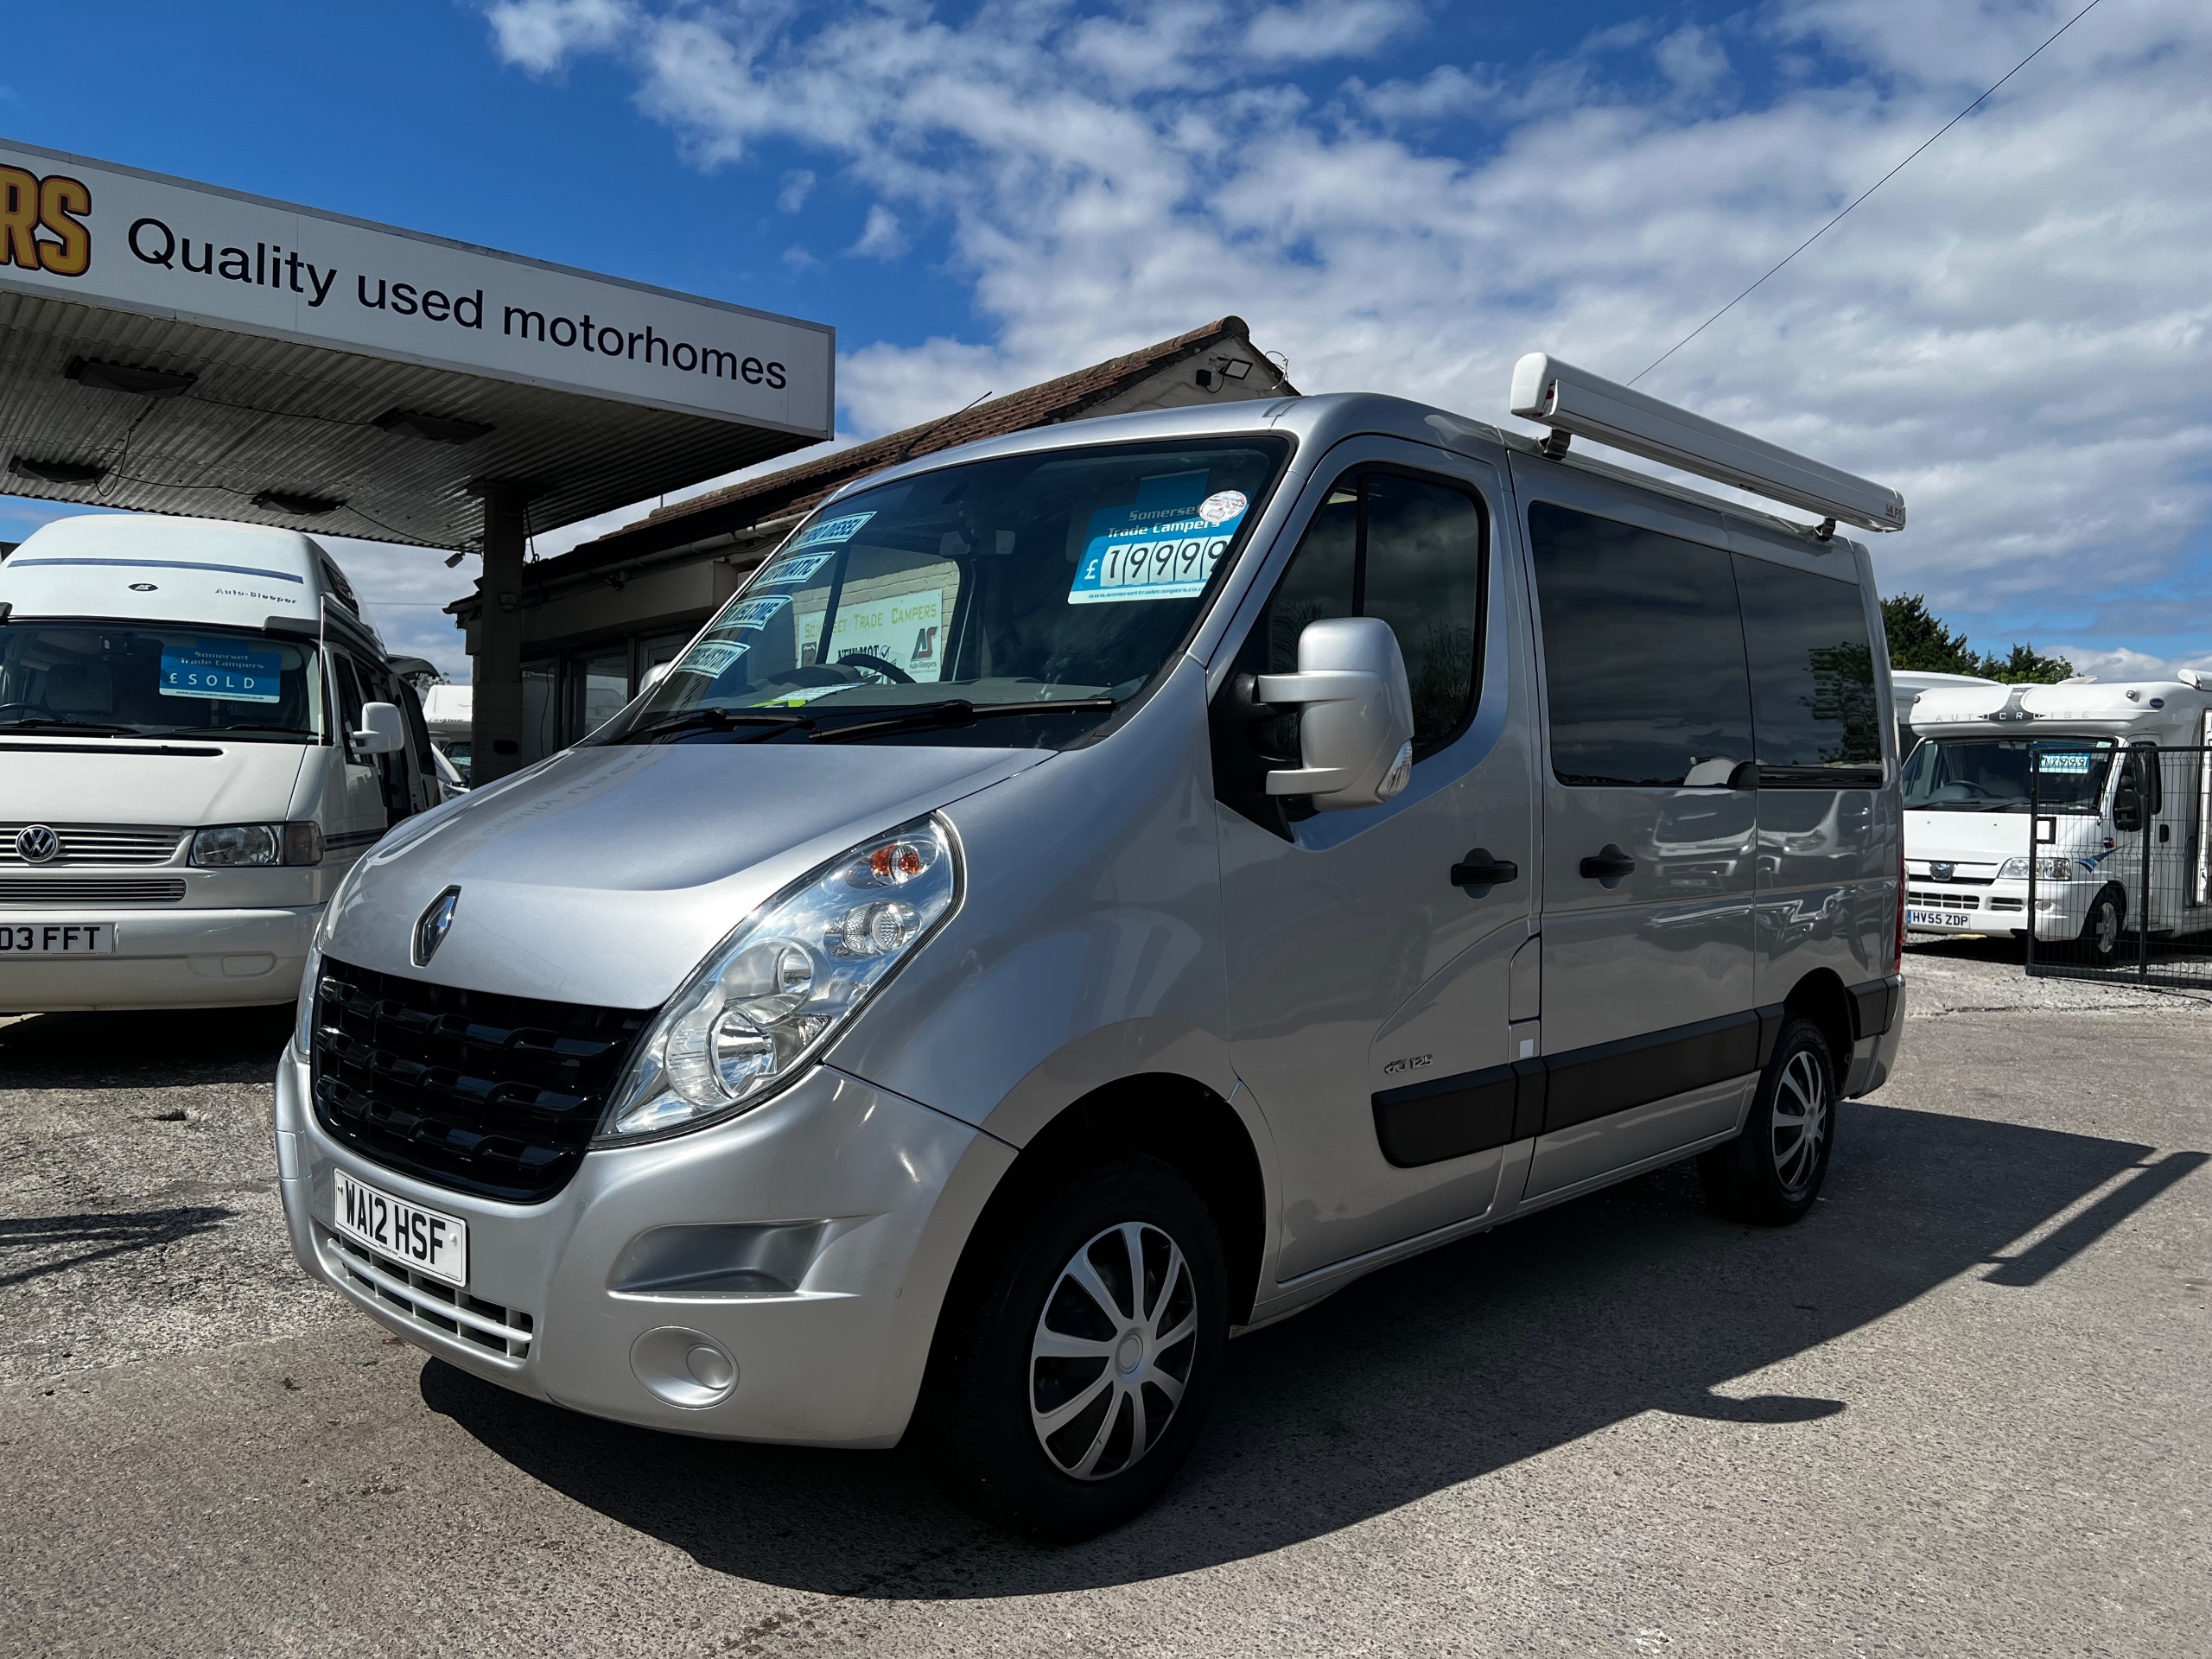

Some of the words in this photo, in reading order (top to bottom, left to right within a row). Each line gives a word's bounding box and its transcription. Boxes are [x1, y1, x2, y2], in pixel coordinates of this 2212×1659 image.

[128, 218, 338, 308] Quality
[357, 275, 484, 330] used
[503, 305, 788, 390] motorhomes
[1128, 504, 1202, 522] Somerset
[1107, 526, 1148, 538] Trade
[1152, 520, 1221, 535] Campers
[728, 602, 780, 623] WELCOME
[804, 619, 847, 639] SOMSET
[854, 612, 883, 630] TRADE
[892, 603, 937, 625] CAMPERS
[180, 657, 212, 665] Trade
[215, 659, 264, 669] Campers
[194, 651, 250, 661] Somerset
[1912, 912, 1942, 925] HV55
[1945, 914, 1968, 926] ZDP
[0, 926, 33, 950] 03
[42, 926, 100, 950] FFT
[346, 1179, 388, 1245] WA12
[394, 1204, 447, 1265] HSF
